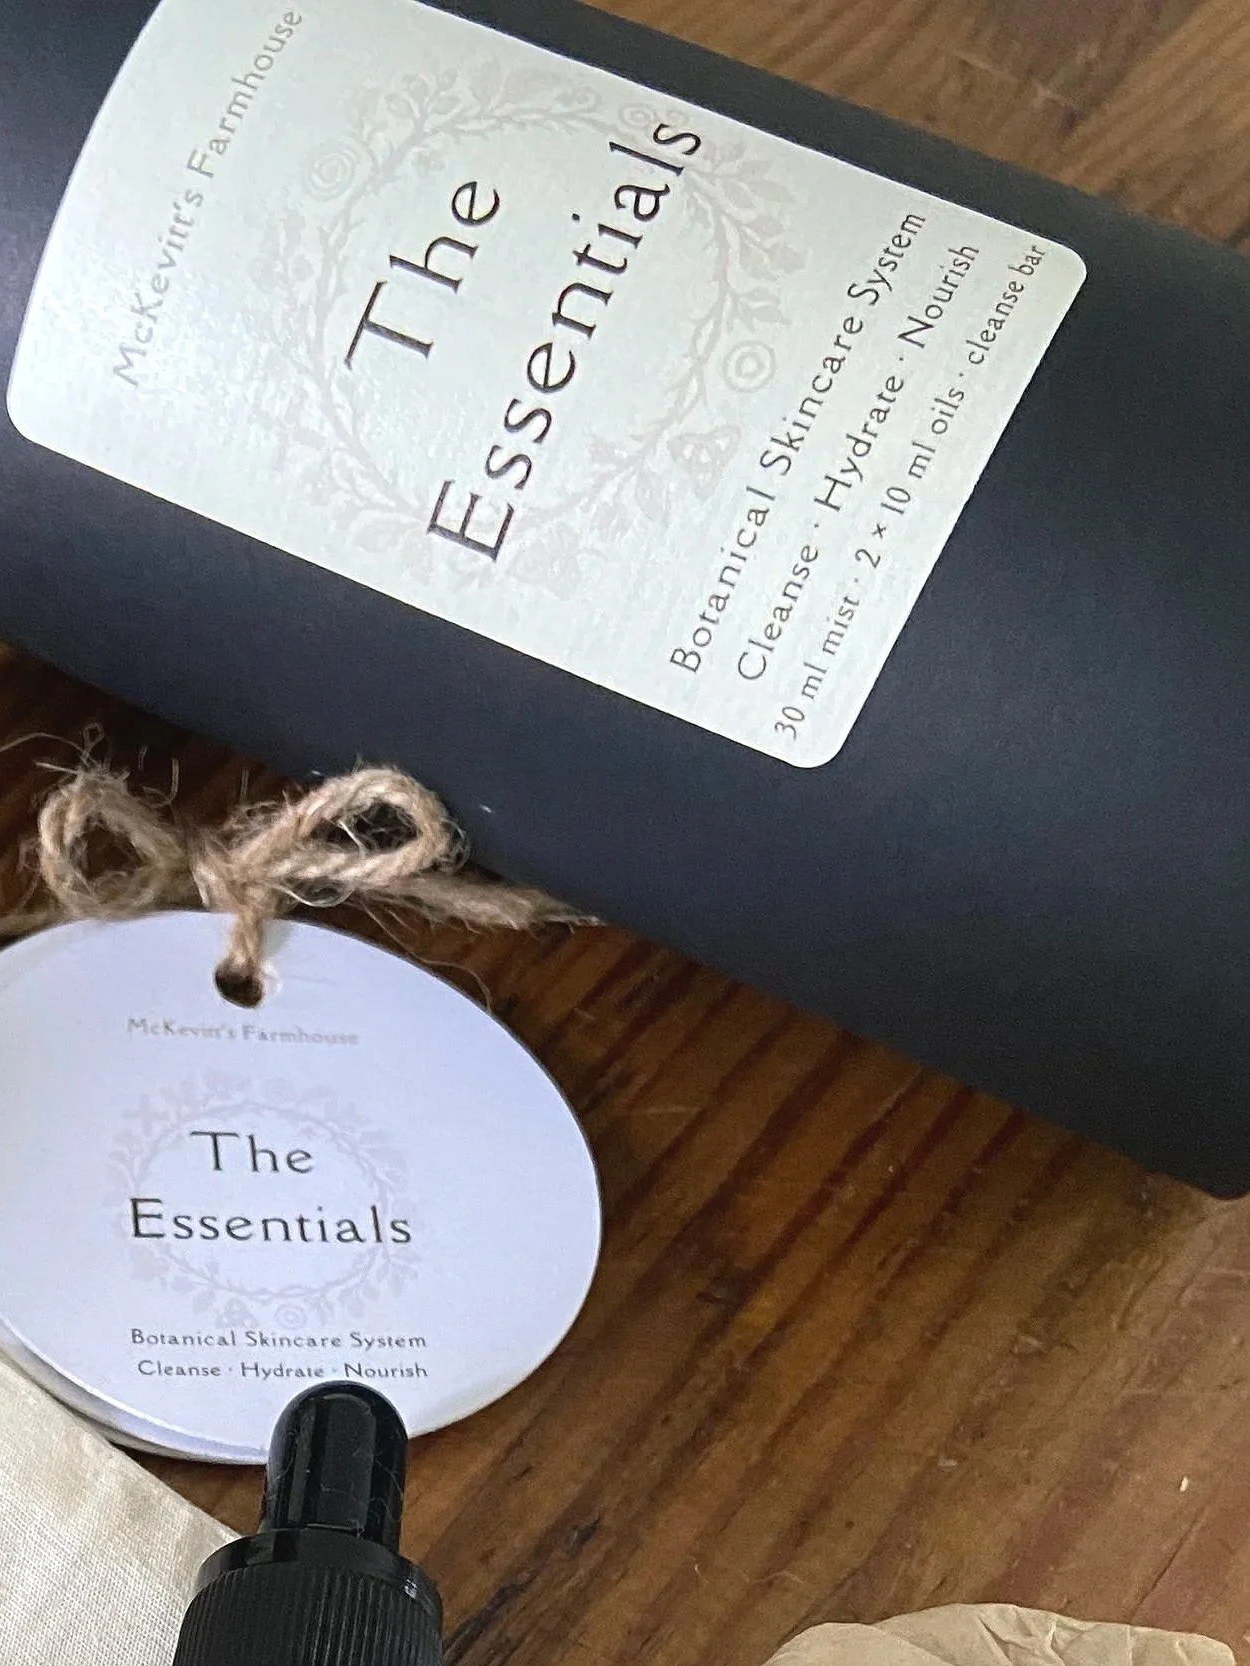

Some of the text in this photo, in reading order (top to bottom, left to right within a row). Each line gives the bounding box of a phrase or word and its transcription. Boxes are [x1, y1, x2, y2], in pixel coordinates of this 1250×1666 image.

[113, 8, 304, 388] McKevitt's Farmhouse
[344, 180, 502, 371] The
[426, 123, 702, 564] Essentials
[670, 212, 928, 674] Botanical Skincare System
[738, 243, 981, 682] Cleanse Hydrate Nourish
[774, 705, 806, 740] 30
[800, 662, 828, 702] ml
[821, 595, 860, 661] mist
[854, 546, 882, 570] 2
[880, 485, 912, 518] 10
[907, 439, 936, 482] ml
[931, 387, 966, 437] oils
[966, 279, 1025, 366] cleanse
[1012, 244, 1047, 277] bar
[242, 1024, 360, 1046] Farmhouse
[129, 1197, 413, 1245] Essentials
[190, 1130, 315, 1174] The
[130, 1328, 428, 1351] Botanical Skincare System
[137, 1360, 429, 1380] Cleanse Hydrate Nourish
